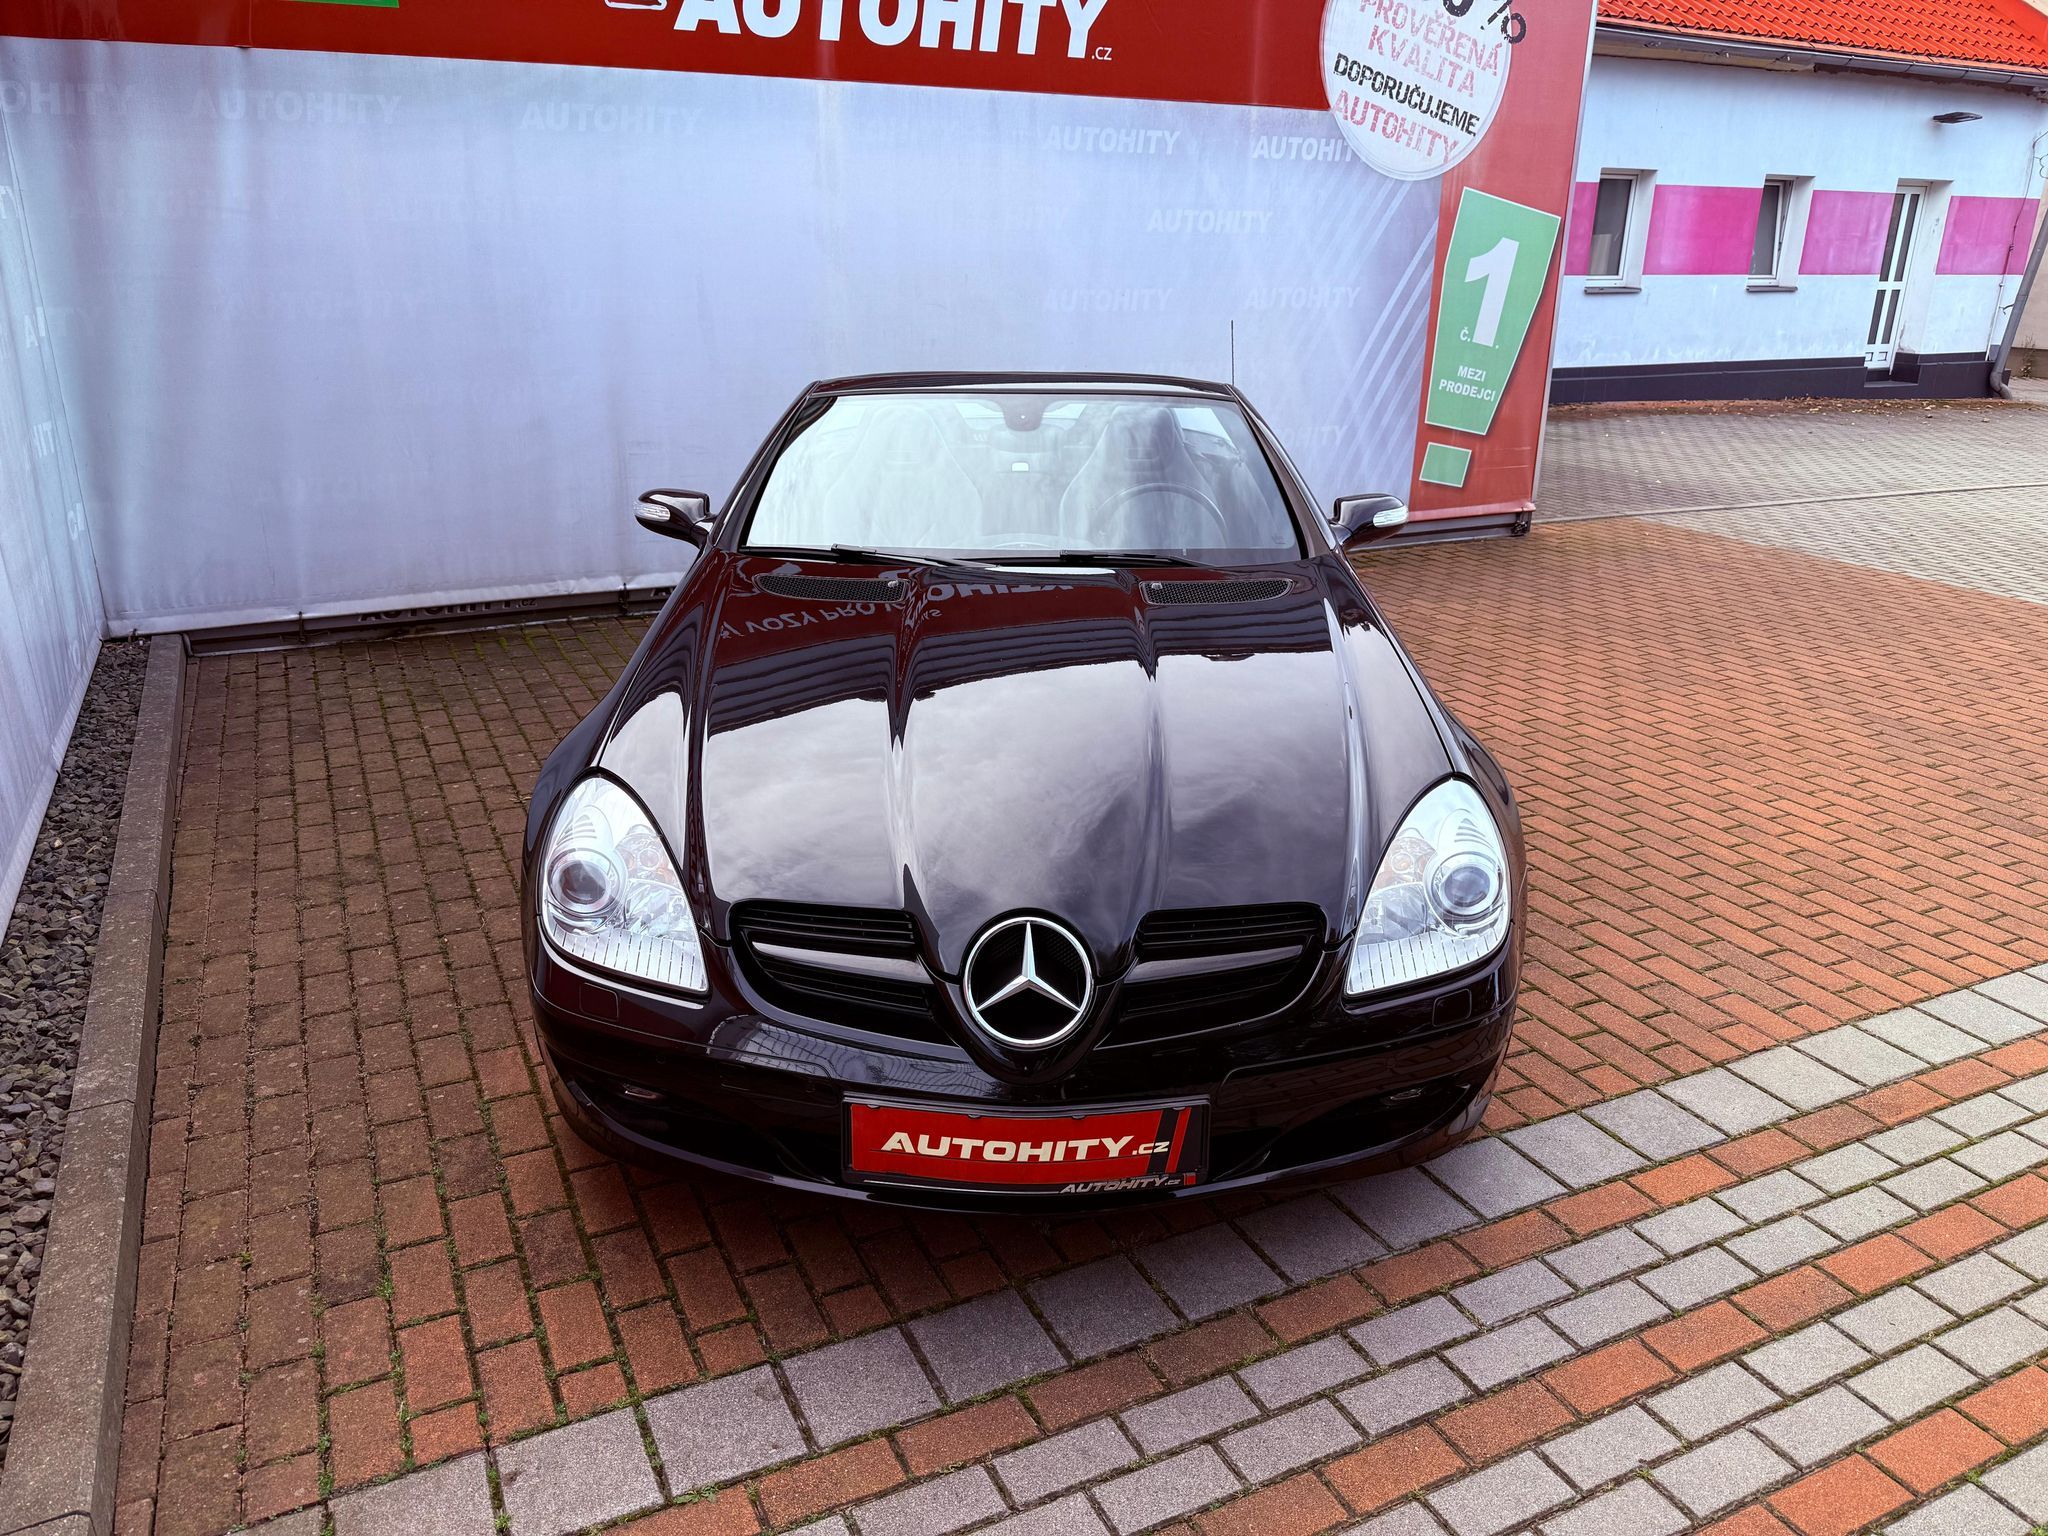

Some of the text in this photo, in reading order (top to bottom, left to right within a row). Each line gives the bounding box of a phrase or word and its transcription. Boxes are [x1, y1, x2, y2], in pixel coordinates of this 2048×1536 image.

[1367, 24, 1476, 98] KVALITA
[1332, 52, 1481, 137] DOPORUČUJEME
[1044, 124, 1181, 155] AUTOHITY
[1332, 88, 1460, 164] AUTOHITY
[1251, 134, 1362, 163] AUTOHIT
[1147, 208, 1274, 235] AUTOHITY
[1043, 287, 1175, 313] AUTOHITY
[1243, 286, 1362, 310] AUTOHITY
[1457, 365, 1486, 382] MEZI
[1438, 378, 1496, 402] PRODEJCI
